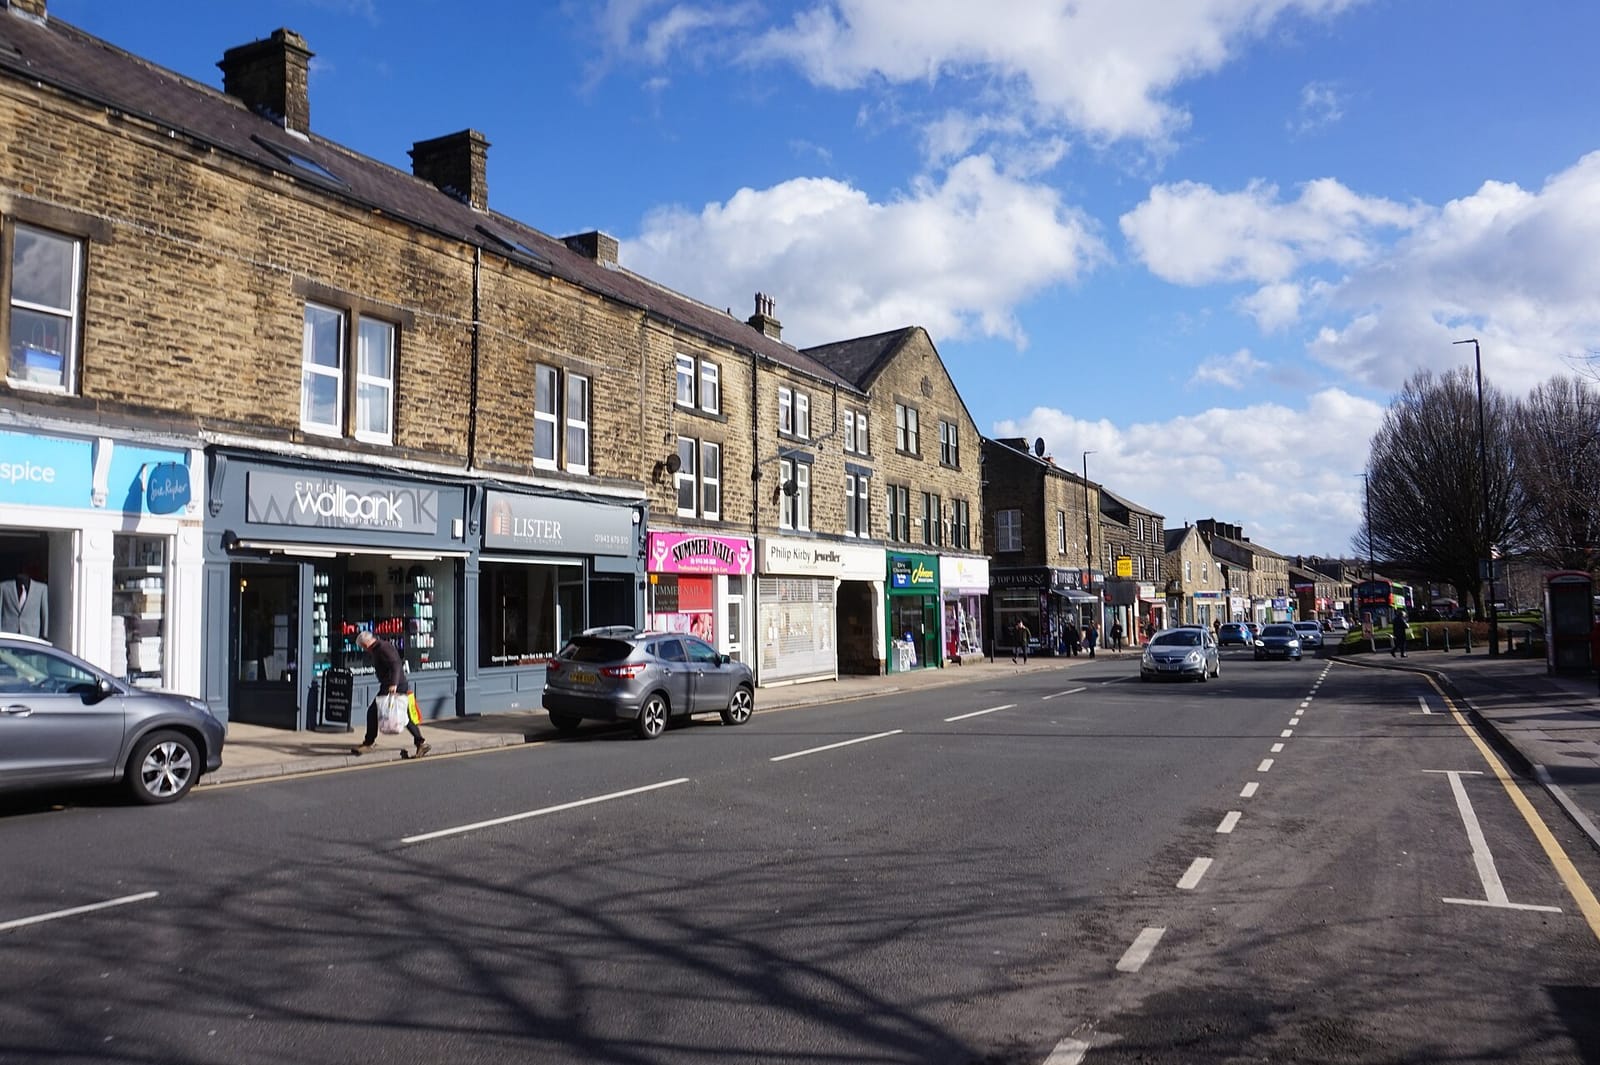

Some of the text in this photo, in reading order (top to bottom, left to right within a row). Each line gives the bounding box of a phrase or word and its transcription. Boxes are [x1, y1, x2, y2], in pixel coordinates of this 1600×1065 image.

[295, 481, 335, 496] chris
[295, 483, 403, 522] wallbank
[343, 517, 403, 528] hairdressing
[514, 517, 562, 540] LISTER
[672, 538, 710, 563] SUMMER
[711, 539, 736, 566] NAILS
[771, 546, 841, 564] Philip Kirby Jeweller
[997, 575, 1034, 585] TOP FADES
